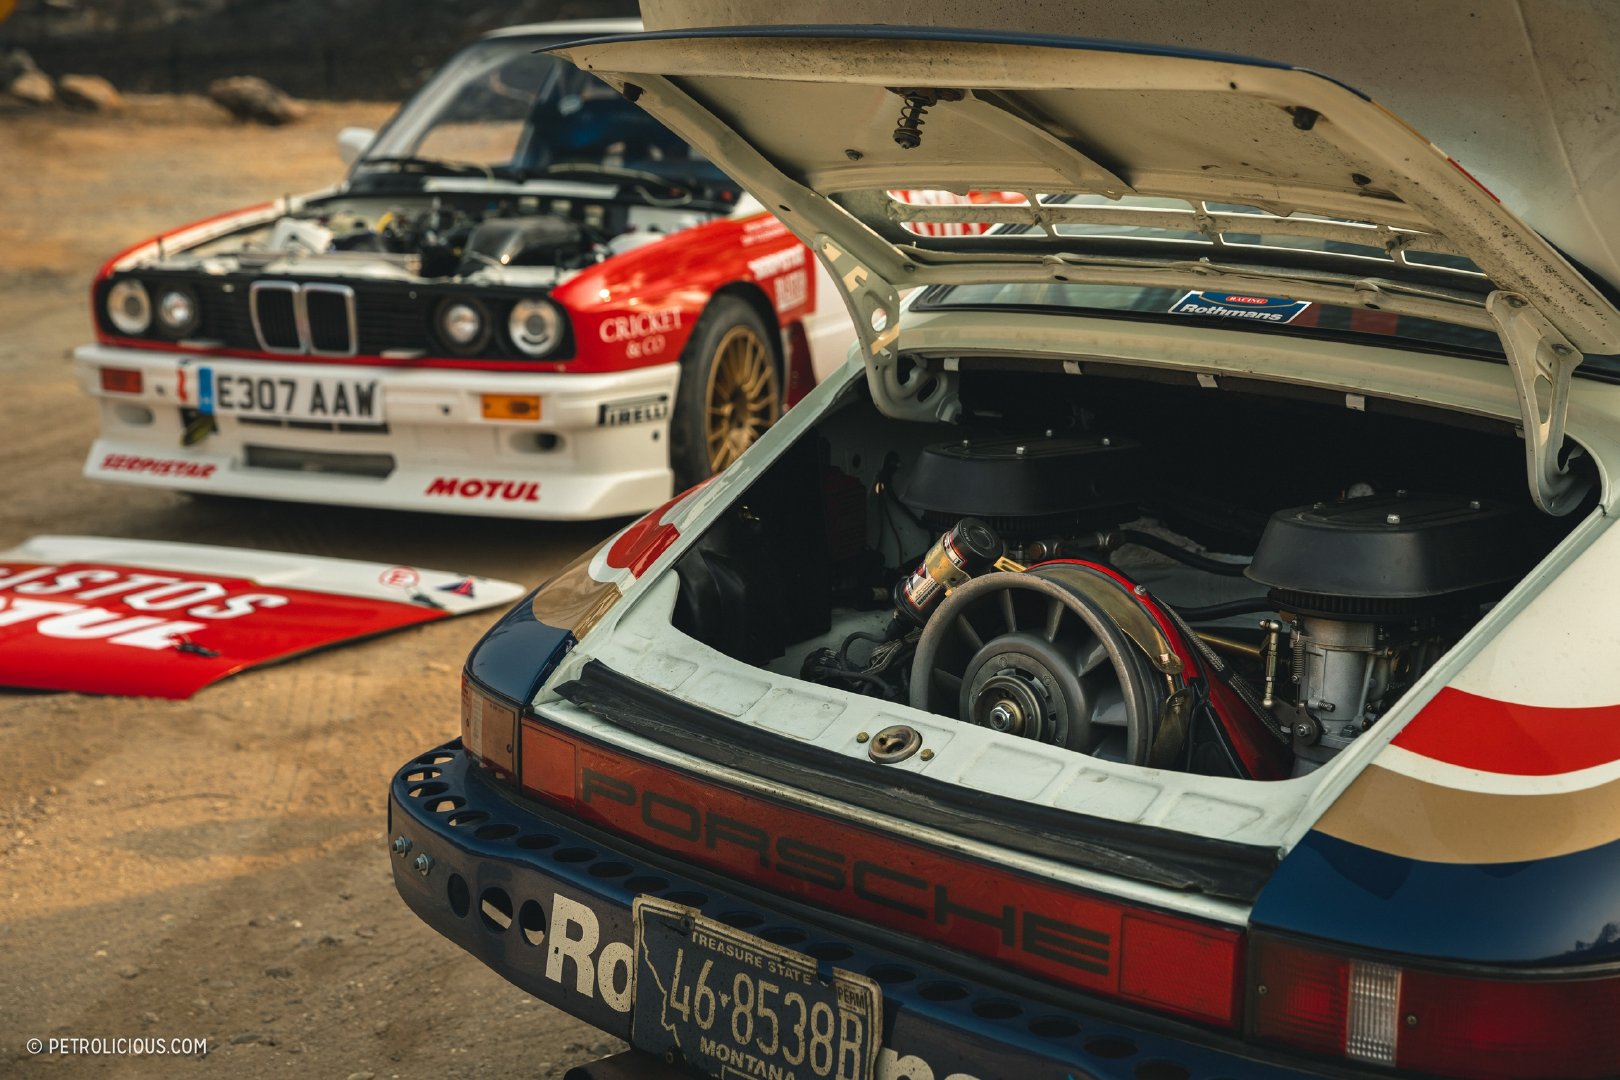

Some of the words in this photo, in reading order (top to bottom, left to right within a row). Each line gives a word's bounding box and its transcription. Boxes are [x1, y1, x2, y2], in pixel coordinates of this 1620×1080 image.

[1180, 304, 1284, 321] Rothmans
[1229, 297, 1268, 305] RACING
[599, 306, 682, 343] CRICKET
[218, 376, 297, 412] E307
[309, 379, 379, 417] AAW
[425, 477, 542, 503] MOTUL
[581, 766, 1111, 977] PORSCHE
[692, 931, 762, 969] TREASURE
[768, 960, 813, 986] STATE
